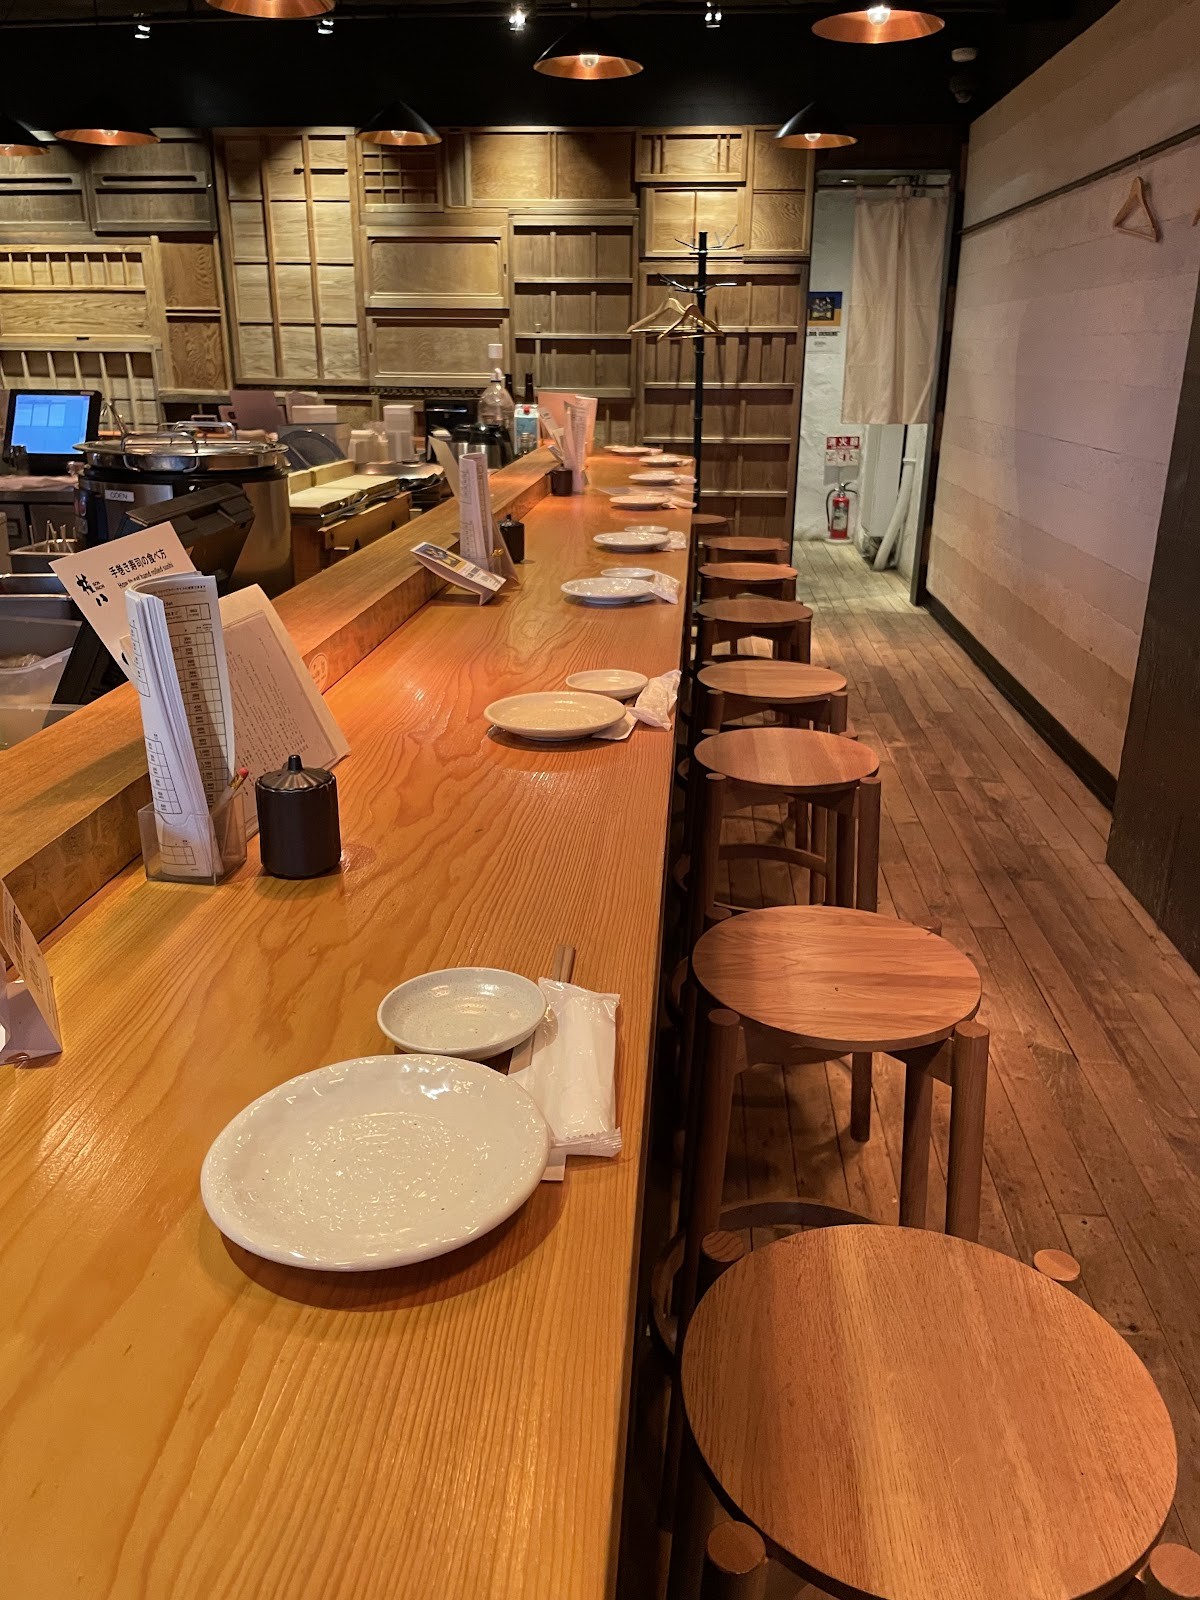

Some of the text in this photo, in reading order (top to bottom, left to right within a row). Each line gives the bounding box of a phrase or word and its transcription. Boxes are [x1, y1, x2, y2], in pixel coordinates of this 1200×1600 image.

[108, 548, 167, 579] 手巻き寿司の食べ方
[117, 581, 129, 589] How
[140, 571, 152, 580] hand
[151, 566, 164, 575] rolled
[162, 561, 174, 571] sushi
